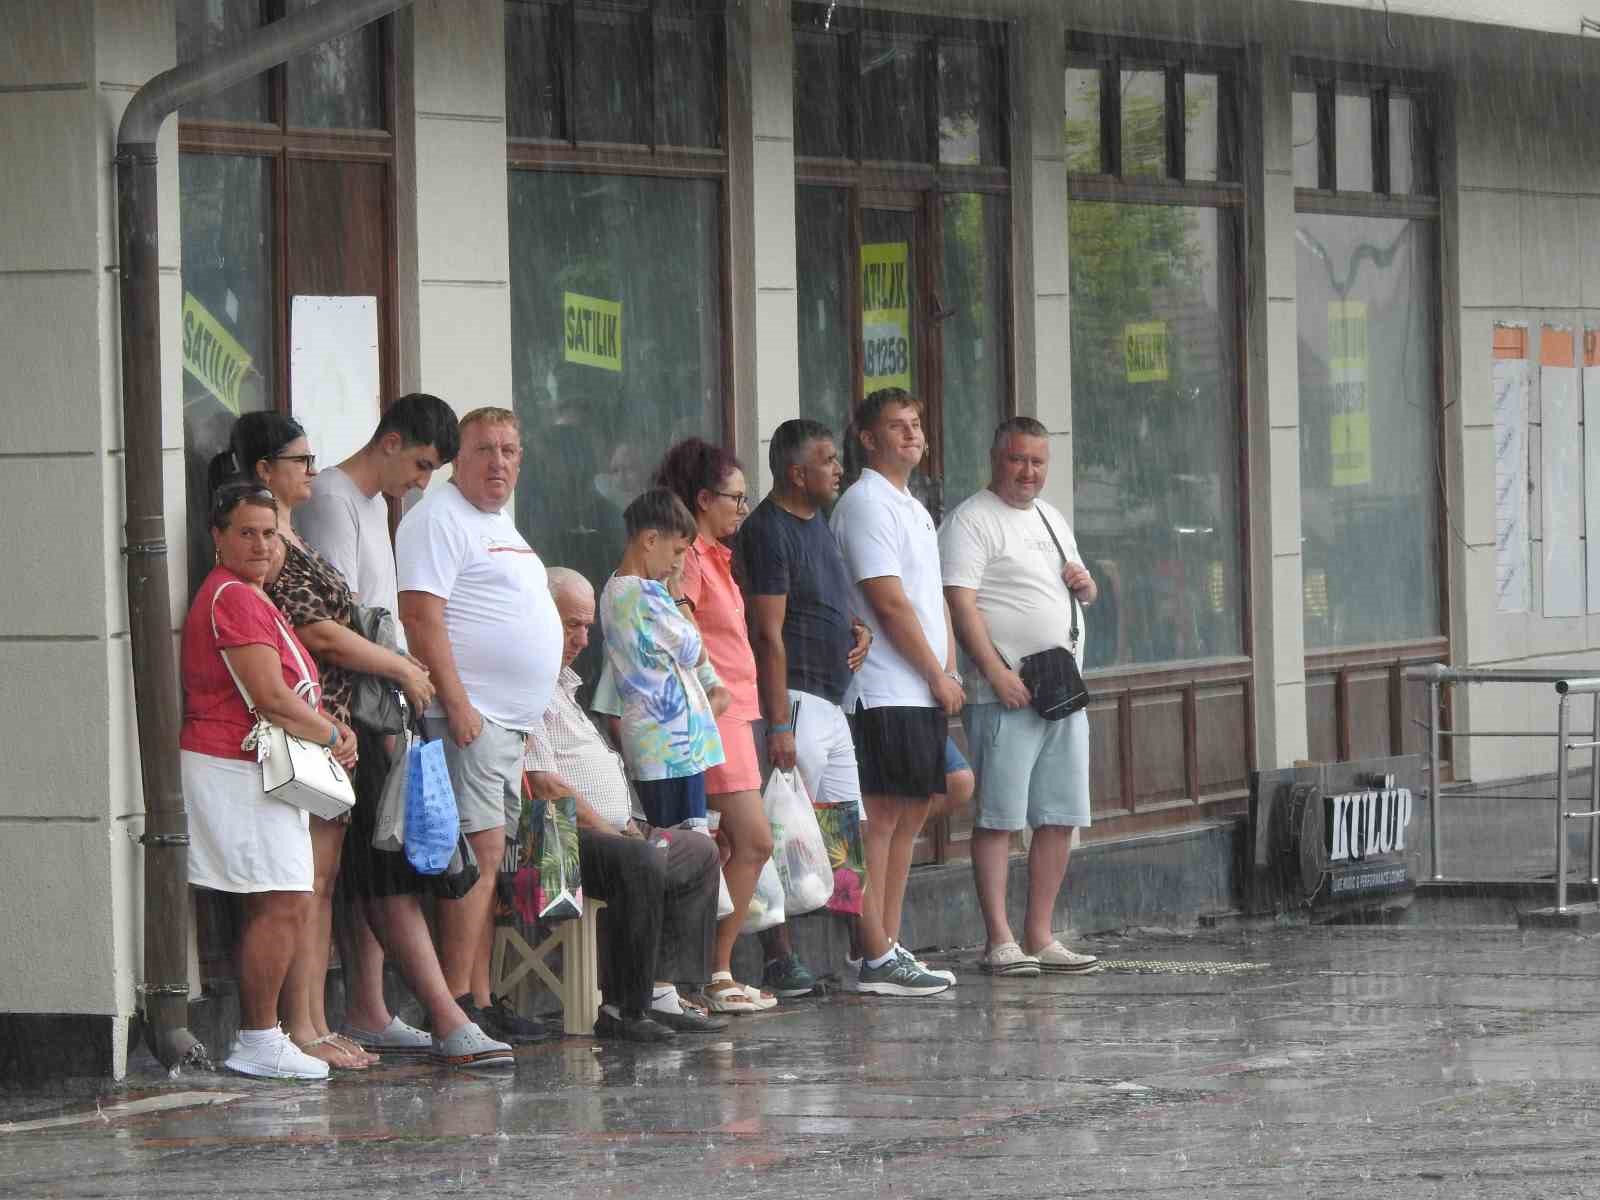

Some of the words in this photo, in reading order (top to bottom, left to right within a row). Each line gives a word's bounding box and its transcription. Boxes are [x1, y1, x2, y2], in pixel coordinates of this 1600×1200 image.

[182, 310, 239, 404] SATILIK
[567, 305, 617, 358] SATILIK
[1331, 774, 1412, 860] KULÜP
